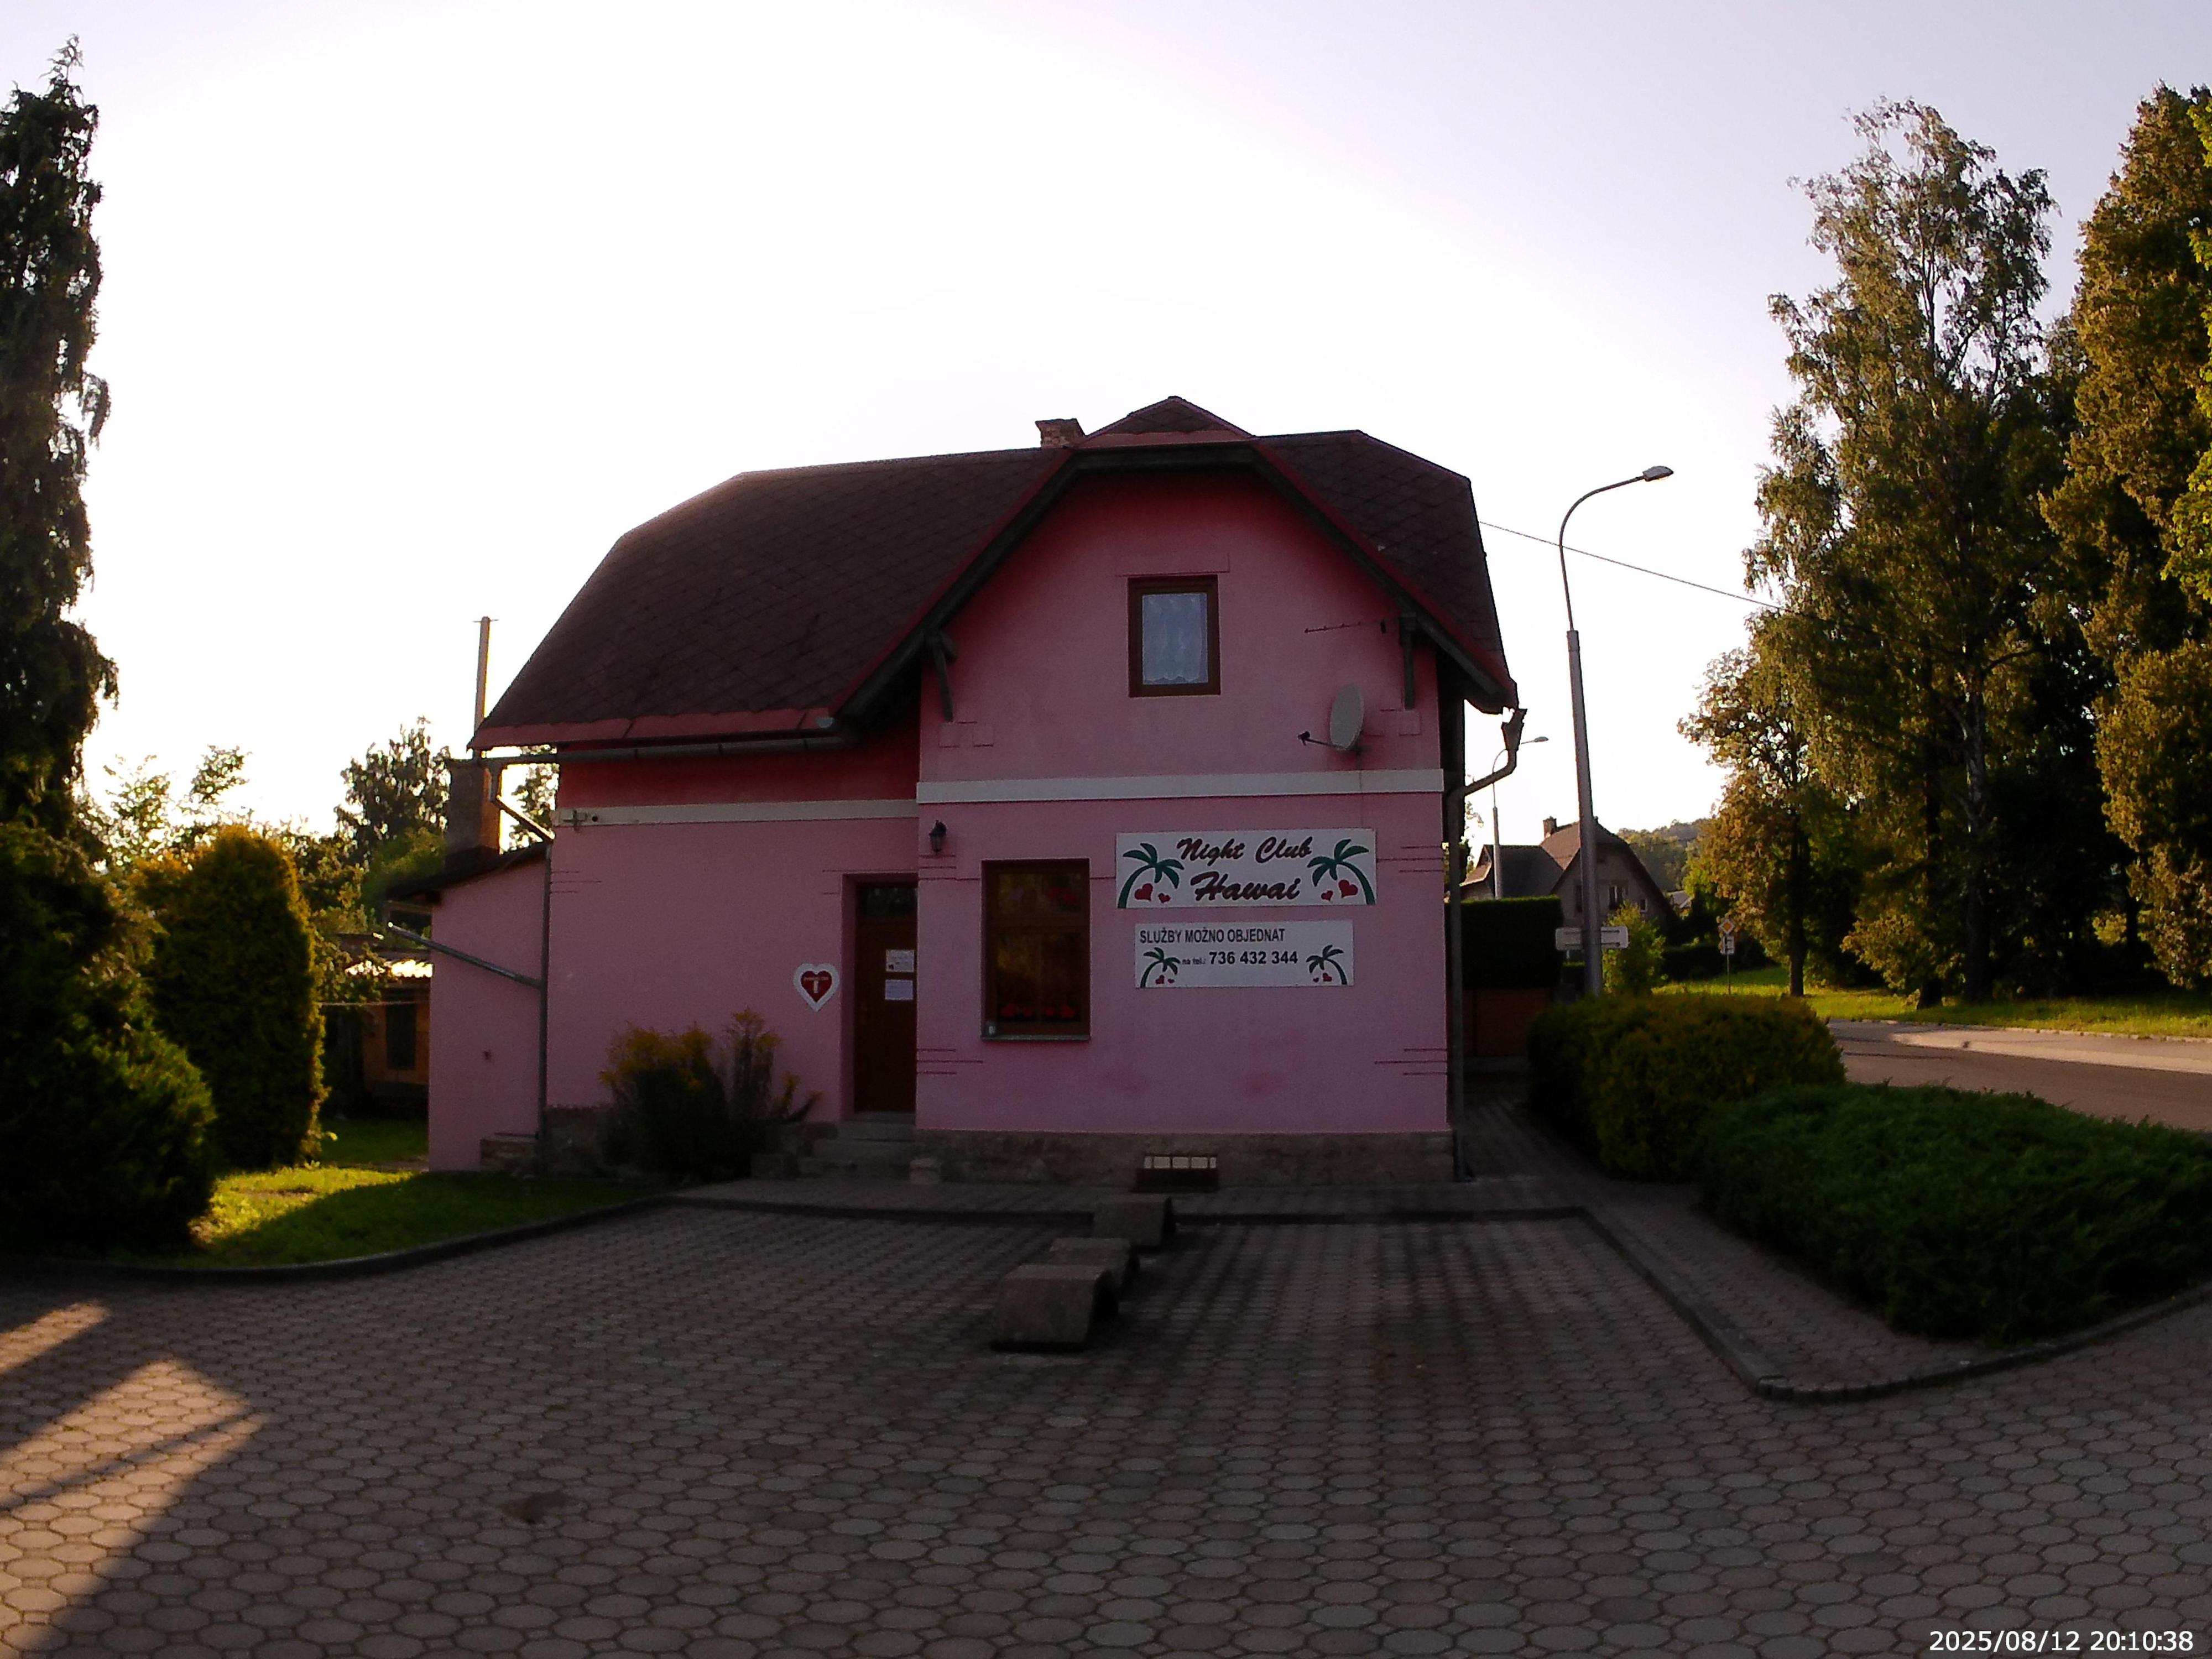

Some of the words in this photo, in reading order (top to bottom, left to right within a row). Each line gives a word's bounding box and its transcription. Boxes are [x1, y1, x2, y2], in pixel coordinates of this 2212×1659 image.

[1177, 838, 1245, 867] Night
[1255, 836, 1313, 863] Club
[1191, 872, 1301, 901] Hawai
[1140, 927, 1182, 943] SLUŽBY
[1186, 927, 1224, 943] MOŽNO
[1227, 928, 1285, 942] OBJEDNAT
[1209, 951, 1235, 965] 736
[1240, 951, 1267, 964] 432
[1271, 951, 1298, 964] 344
